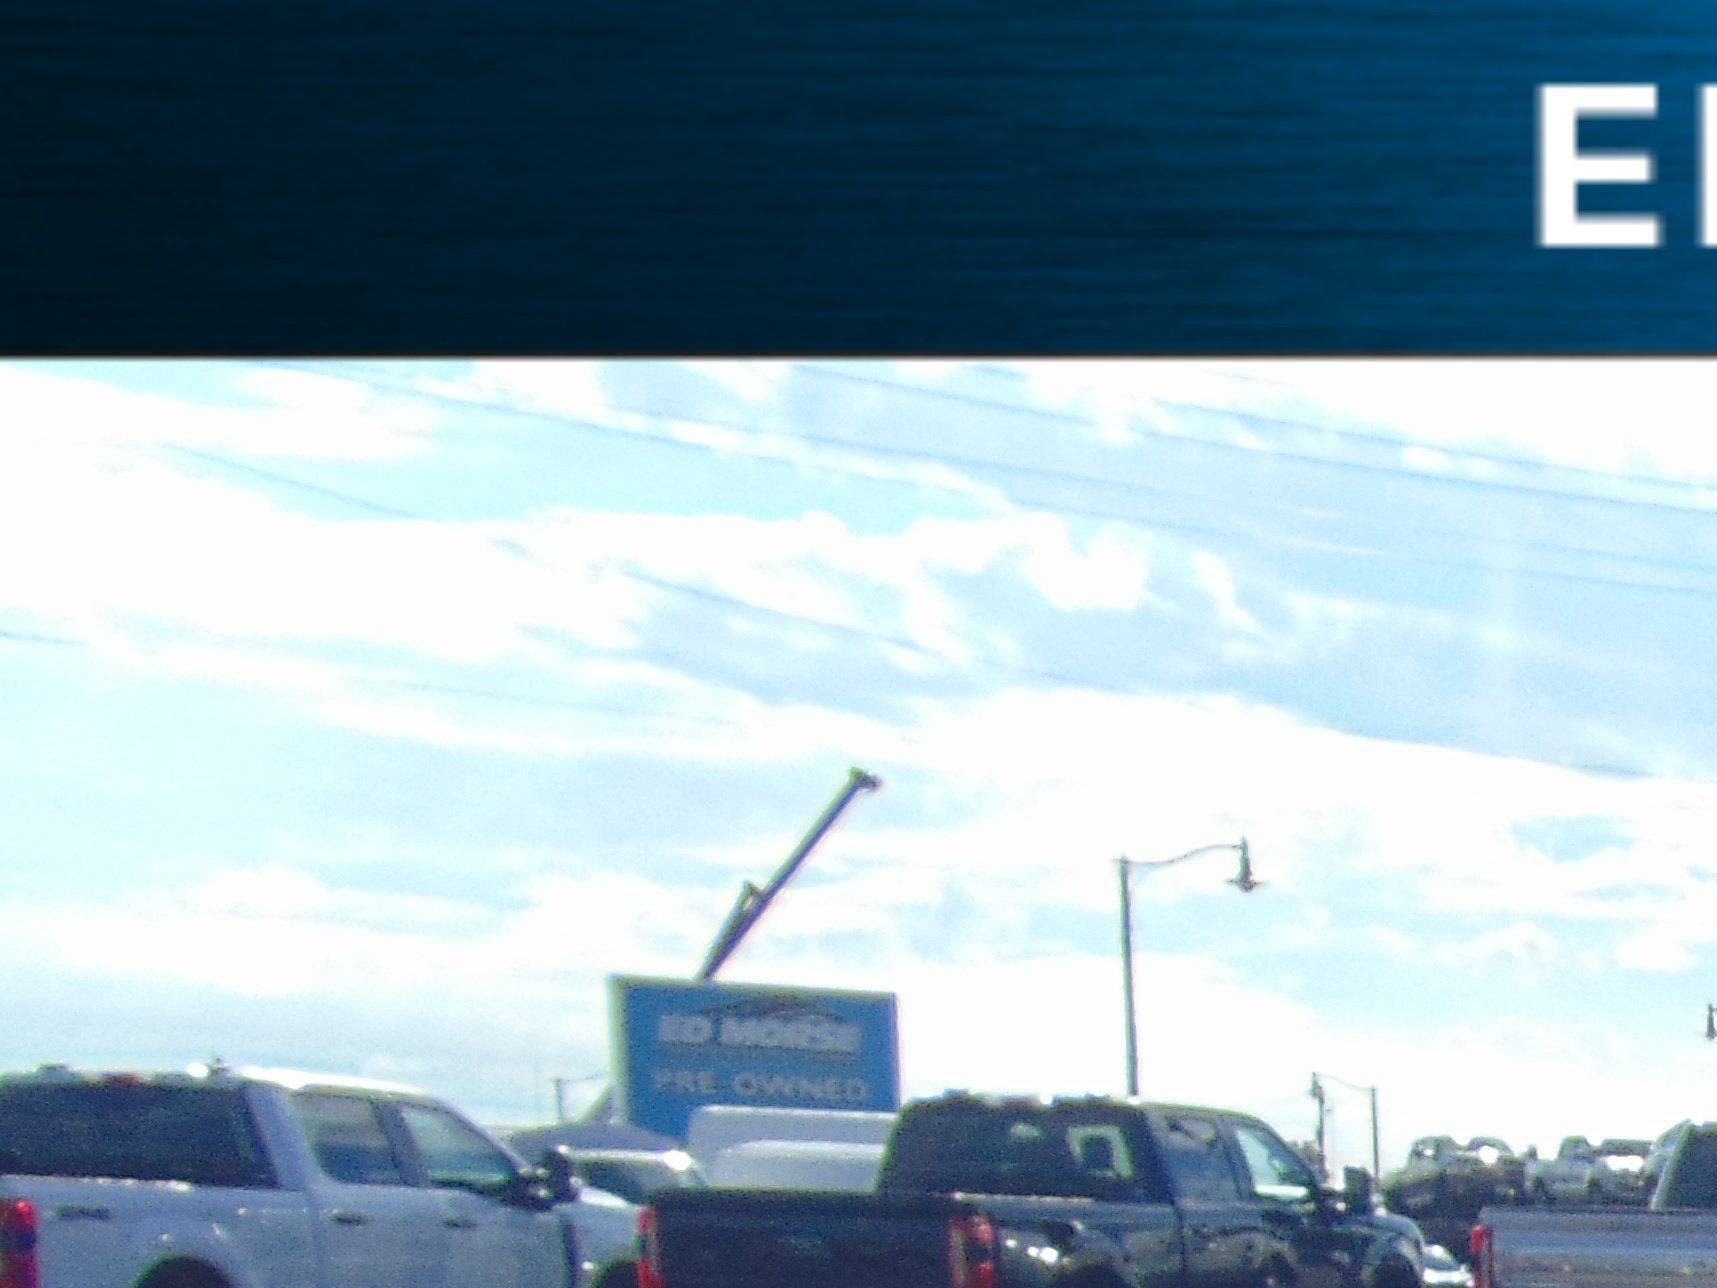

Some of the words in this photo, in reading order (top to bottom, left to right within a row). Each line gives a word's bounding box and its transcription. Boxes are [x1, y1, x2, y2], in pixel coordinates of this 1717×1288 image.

[656, 1014, 713, 1043] ED
[719, 1016, 863, 1052] MORSE
[652, 1067, 717, 1095] PRE
[732, 1072, 868, 1101] OWNED
